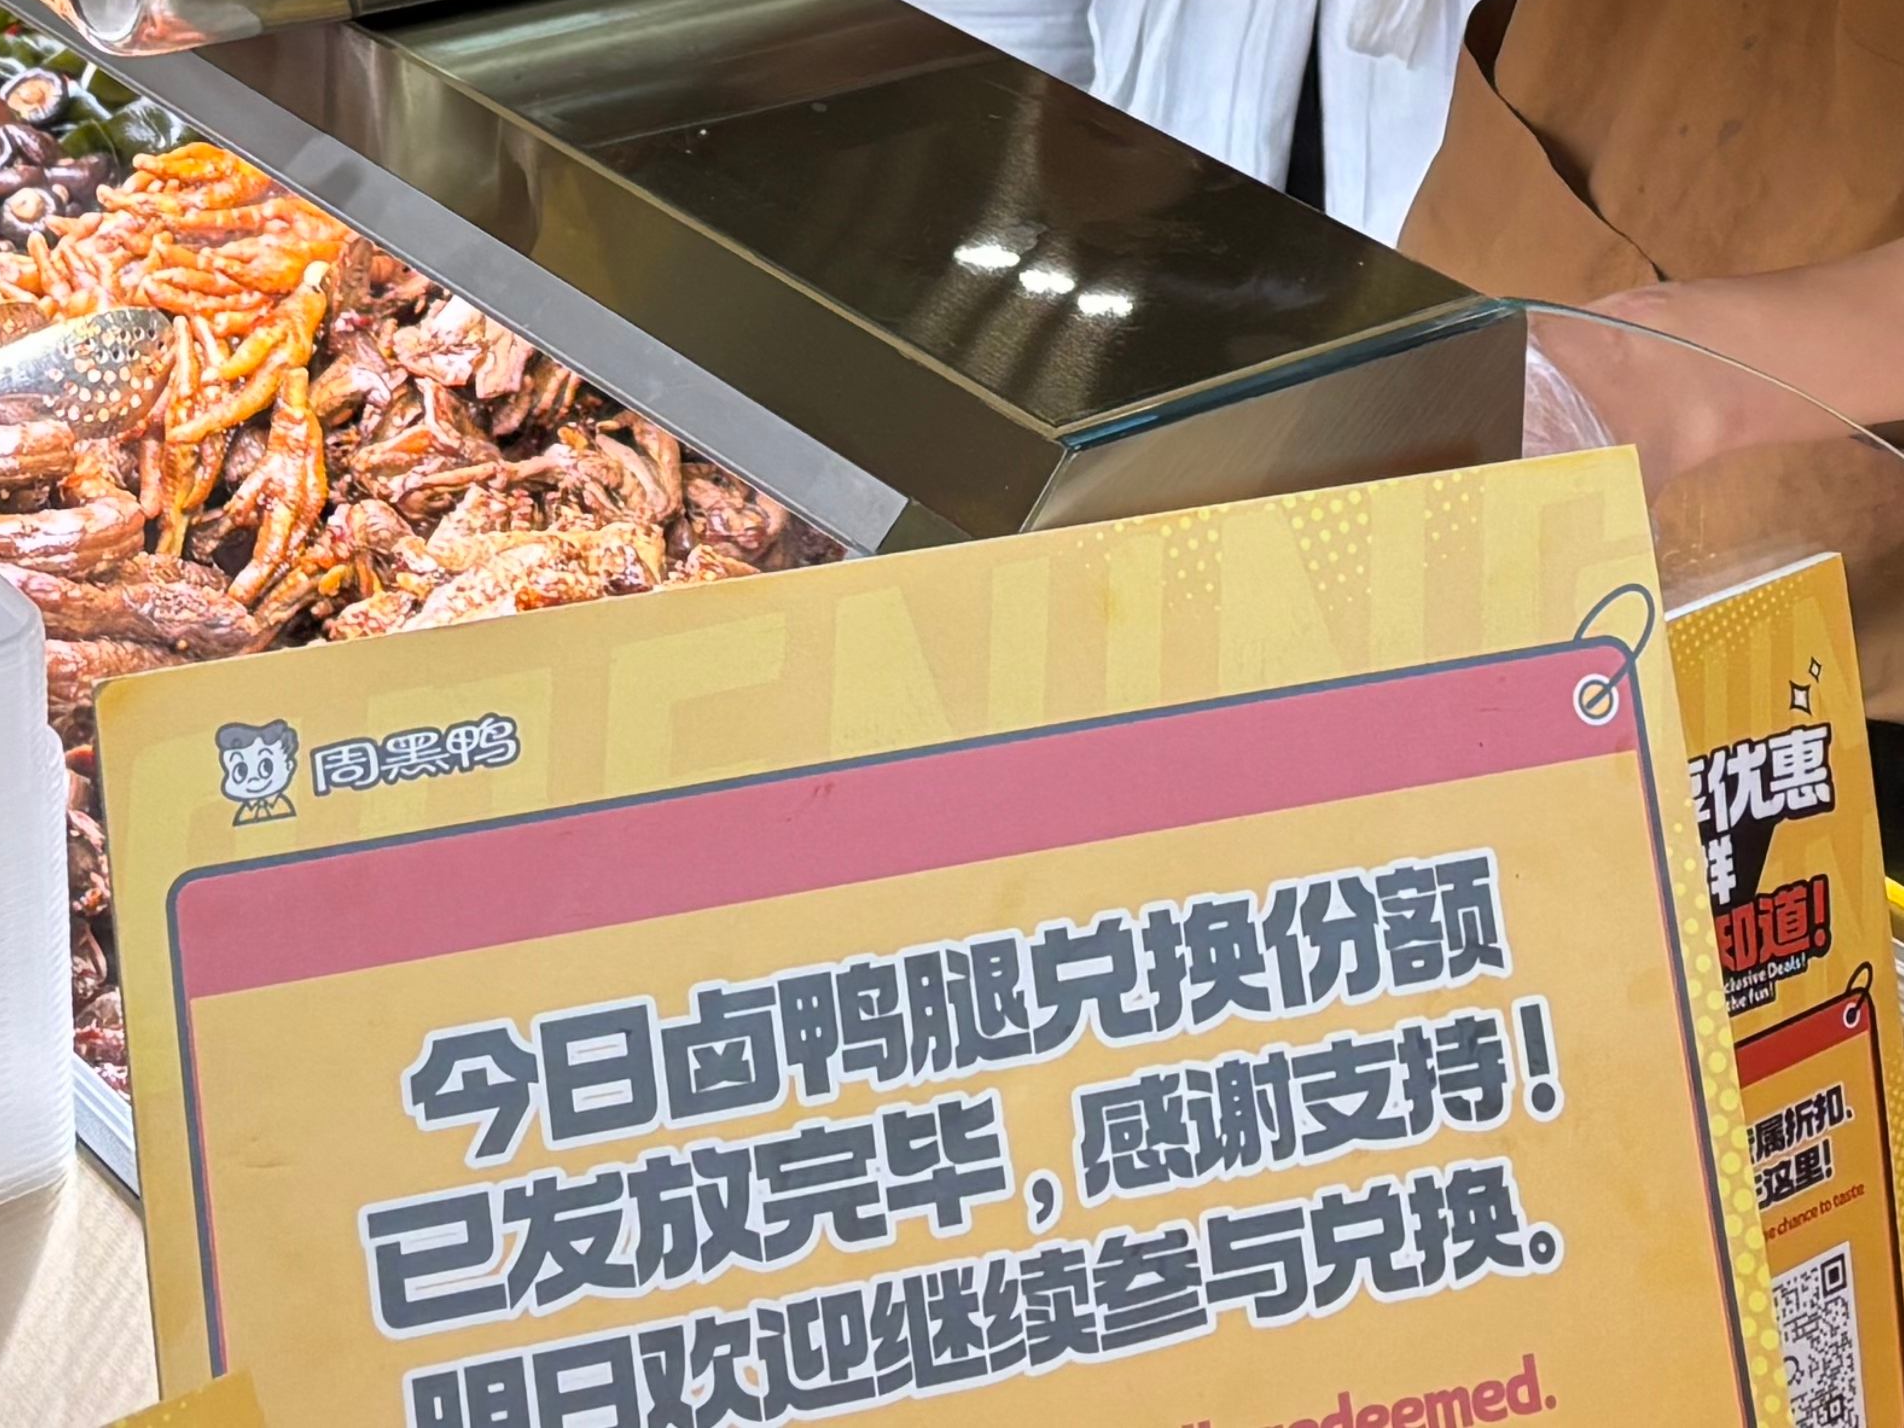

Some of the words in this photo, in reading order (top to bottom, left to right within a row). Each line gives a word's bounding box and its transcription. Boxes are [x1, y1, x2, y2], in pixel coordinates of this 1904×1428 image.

[312, 714, 521, 795] 周黑鸭
[408, 854, 1507, 1160] 今日卤鸭腿兑换份额
[1724, 969, 1766, 994] clusive
